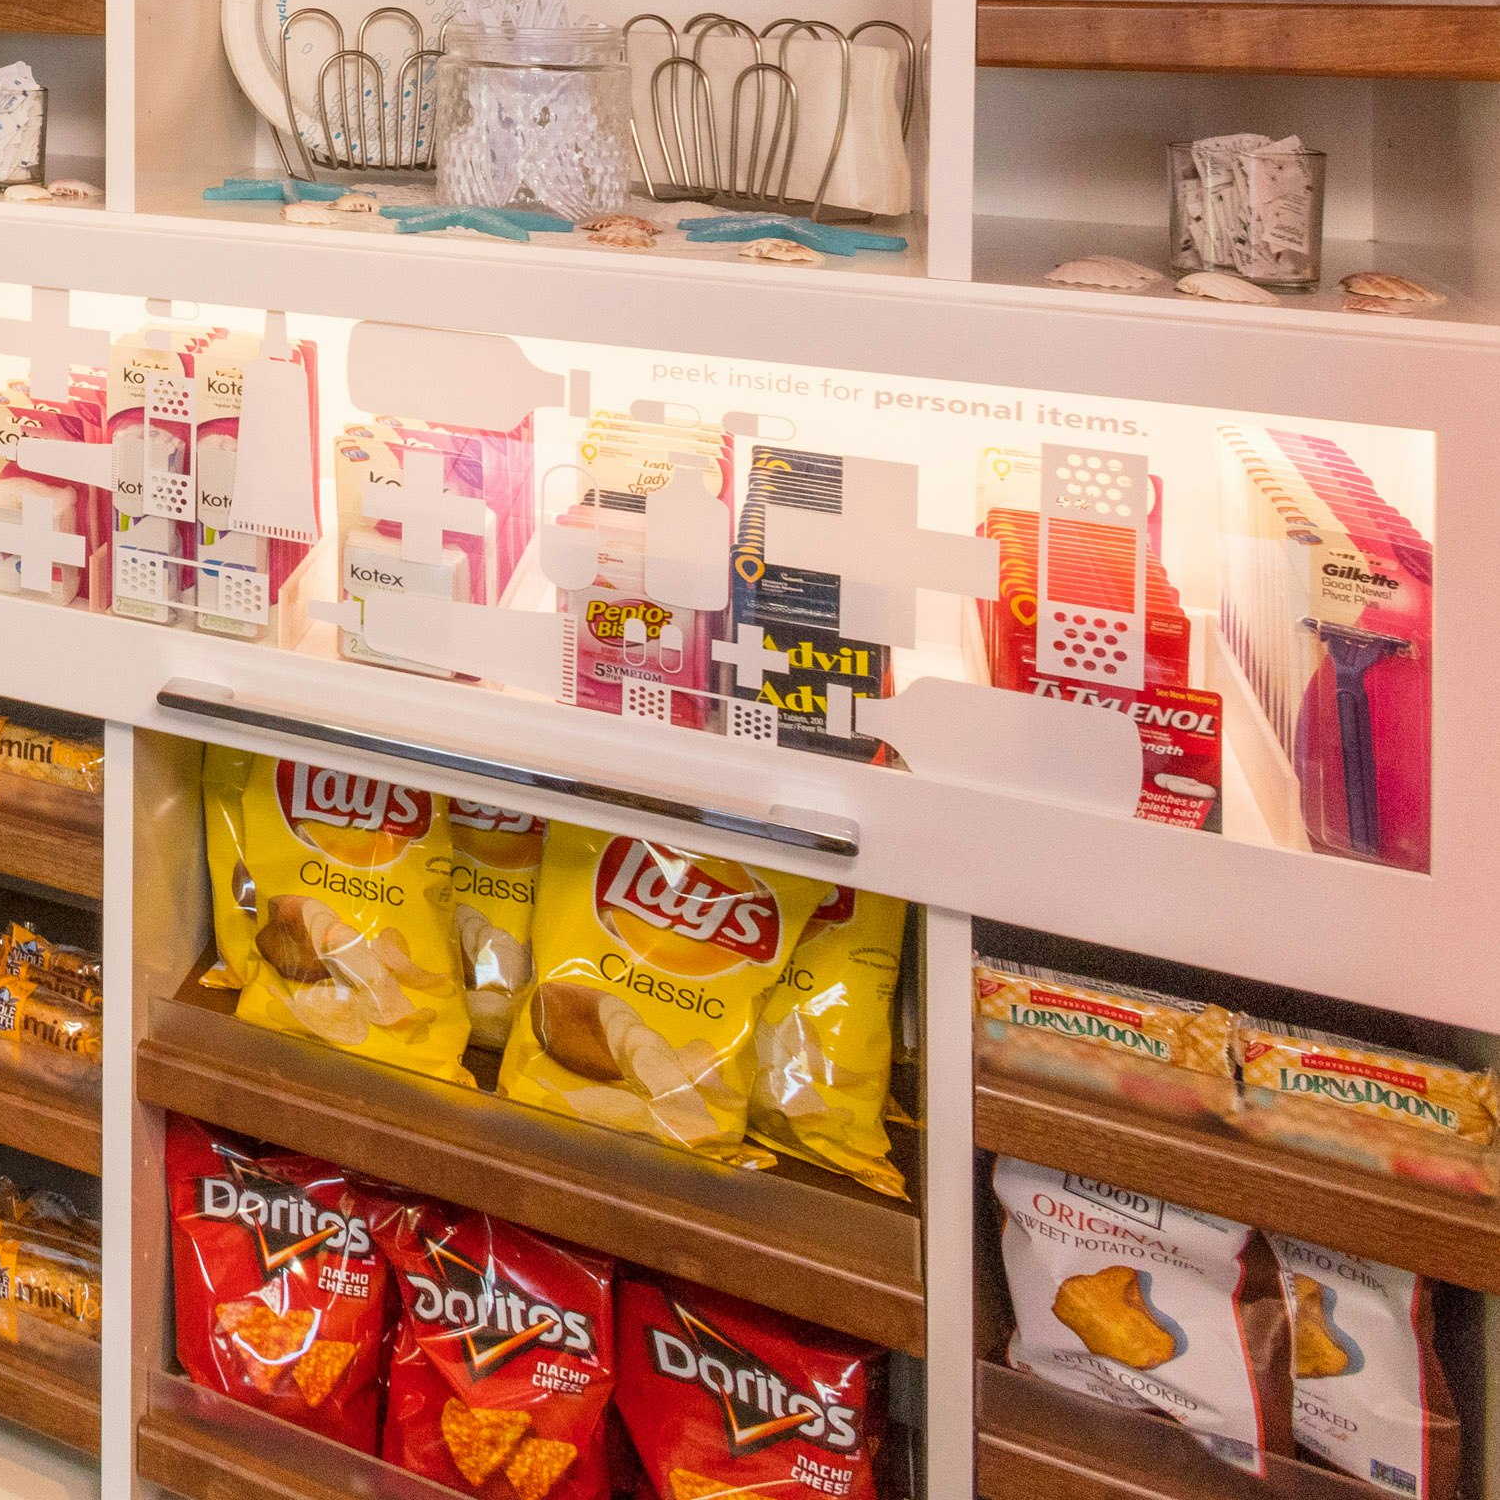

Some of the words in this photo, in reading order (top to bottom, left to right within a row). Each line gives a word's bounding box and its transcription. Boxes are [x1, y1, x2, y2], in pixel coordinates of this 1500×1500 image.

[652, 360, 718, 384] peek
[729, 368, 809, 396] inside
[821, 378, 863, 403] for
[875, 388, 1023, 421] personal
[1037, 404, 1148, 437] items.
[1321, 577, 1352, 592] Good
[1322, 562, 1399, 590] Gillette
[1322, 588, 1351, 604] Pivot
[1354, 593, 1379, 609] Plus
[1141, 742, 1184, 757] ength
[291, 762, 420, 830] Lays
[300, 860, 405, 906] Classic
[451, 865, 536, 905] Classi
[600, 952, 725, 1022] Classic
[202, 1176, 372, 1257] Doritos
[1033, 1192, 1191, 1257] ORIGINAL
[1016, 1210, 1068, 1245] SWEET
[1074, 1235, 1144, 1260] POTATO
[1282, 1240, 1332, 1270] TATO
[317, 1279, 369, 1299] CHEESE
[322, 1264, 370, 1284] NACHO
[405, 1274, 593, 1351] Doritos
[532, 1375, 588, 1394] CHEESE
[536, 1361, 591, 1386] NACHO
[652, 1328, 856, 1447] Doritos
[1118, 1373, 1198, 1412] COOKED
[792, 1472, 851, 1496] CHEESE
[797, 1455, 853, 1483] NACHO
